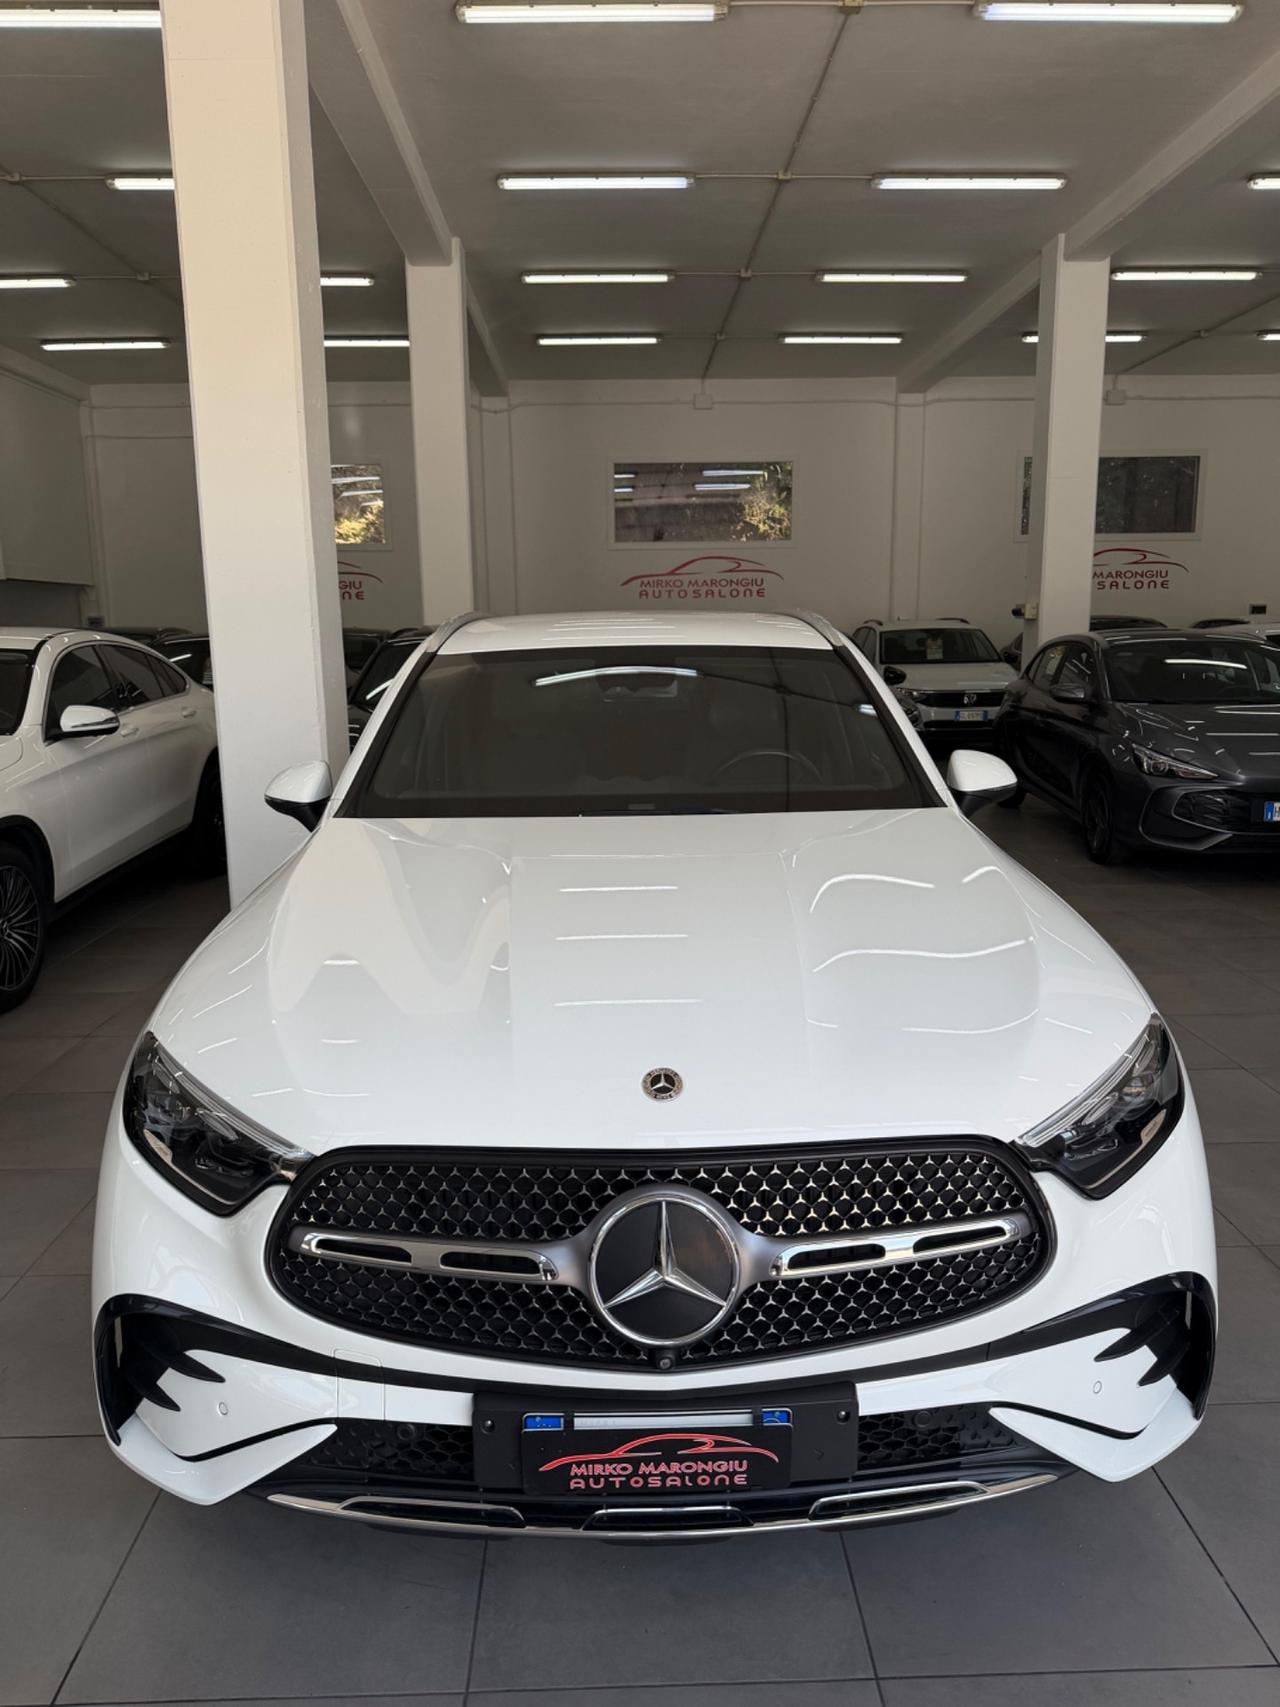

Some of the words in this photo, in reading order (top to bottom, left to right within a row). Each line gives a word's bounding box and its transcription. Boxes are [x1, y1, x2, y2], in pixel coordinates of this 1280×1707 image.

[1092, 570, 1169, 580] MARONGIU
[639, 578, 684, 589] MIRKO
[687, 577, 765, 588] MARONGIU
[1096, 579, 1170, 591] SALONE
[638, 587, 766, 599] AUTOSALONE
[569, 1463, 634, 1477] MIRKO
[638, 1459, 748, 1475] MARONGIU
[569, 1474, 748, 1490] AUTOSALONE
